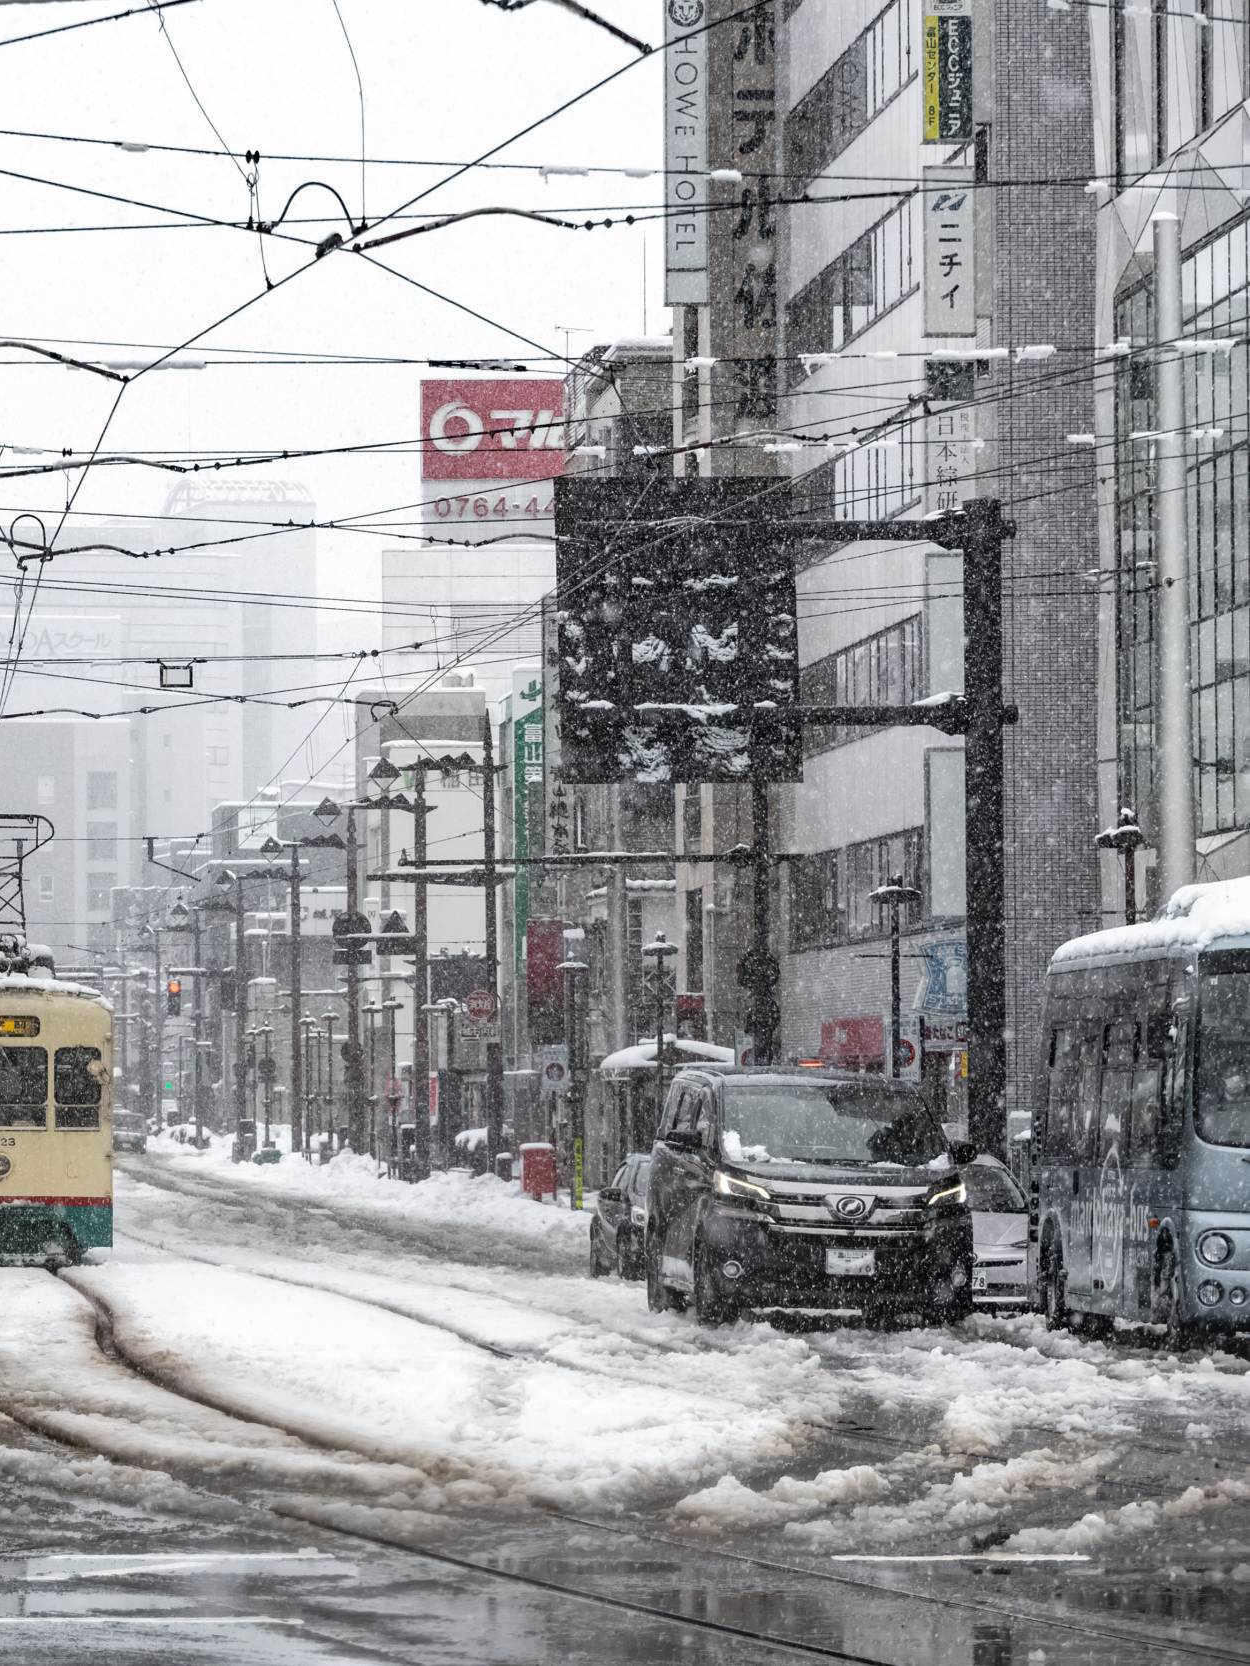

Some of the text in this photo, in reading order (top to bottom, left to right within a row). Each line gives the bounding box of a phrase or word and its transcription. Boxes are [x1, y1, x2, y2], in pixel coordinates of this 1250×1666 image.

[925, 26, 936, 126] 富山センター 8F
[947, 19, 963, 136] ECCジュニア
[673, 36, 699, 251] HOWE HOTEL
[938, 223, 963, 310] ニチイ
